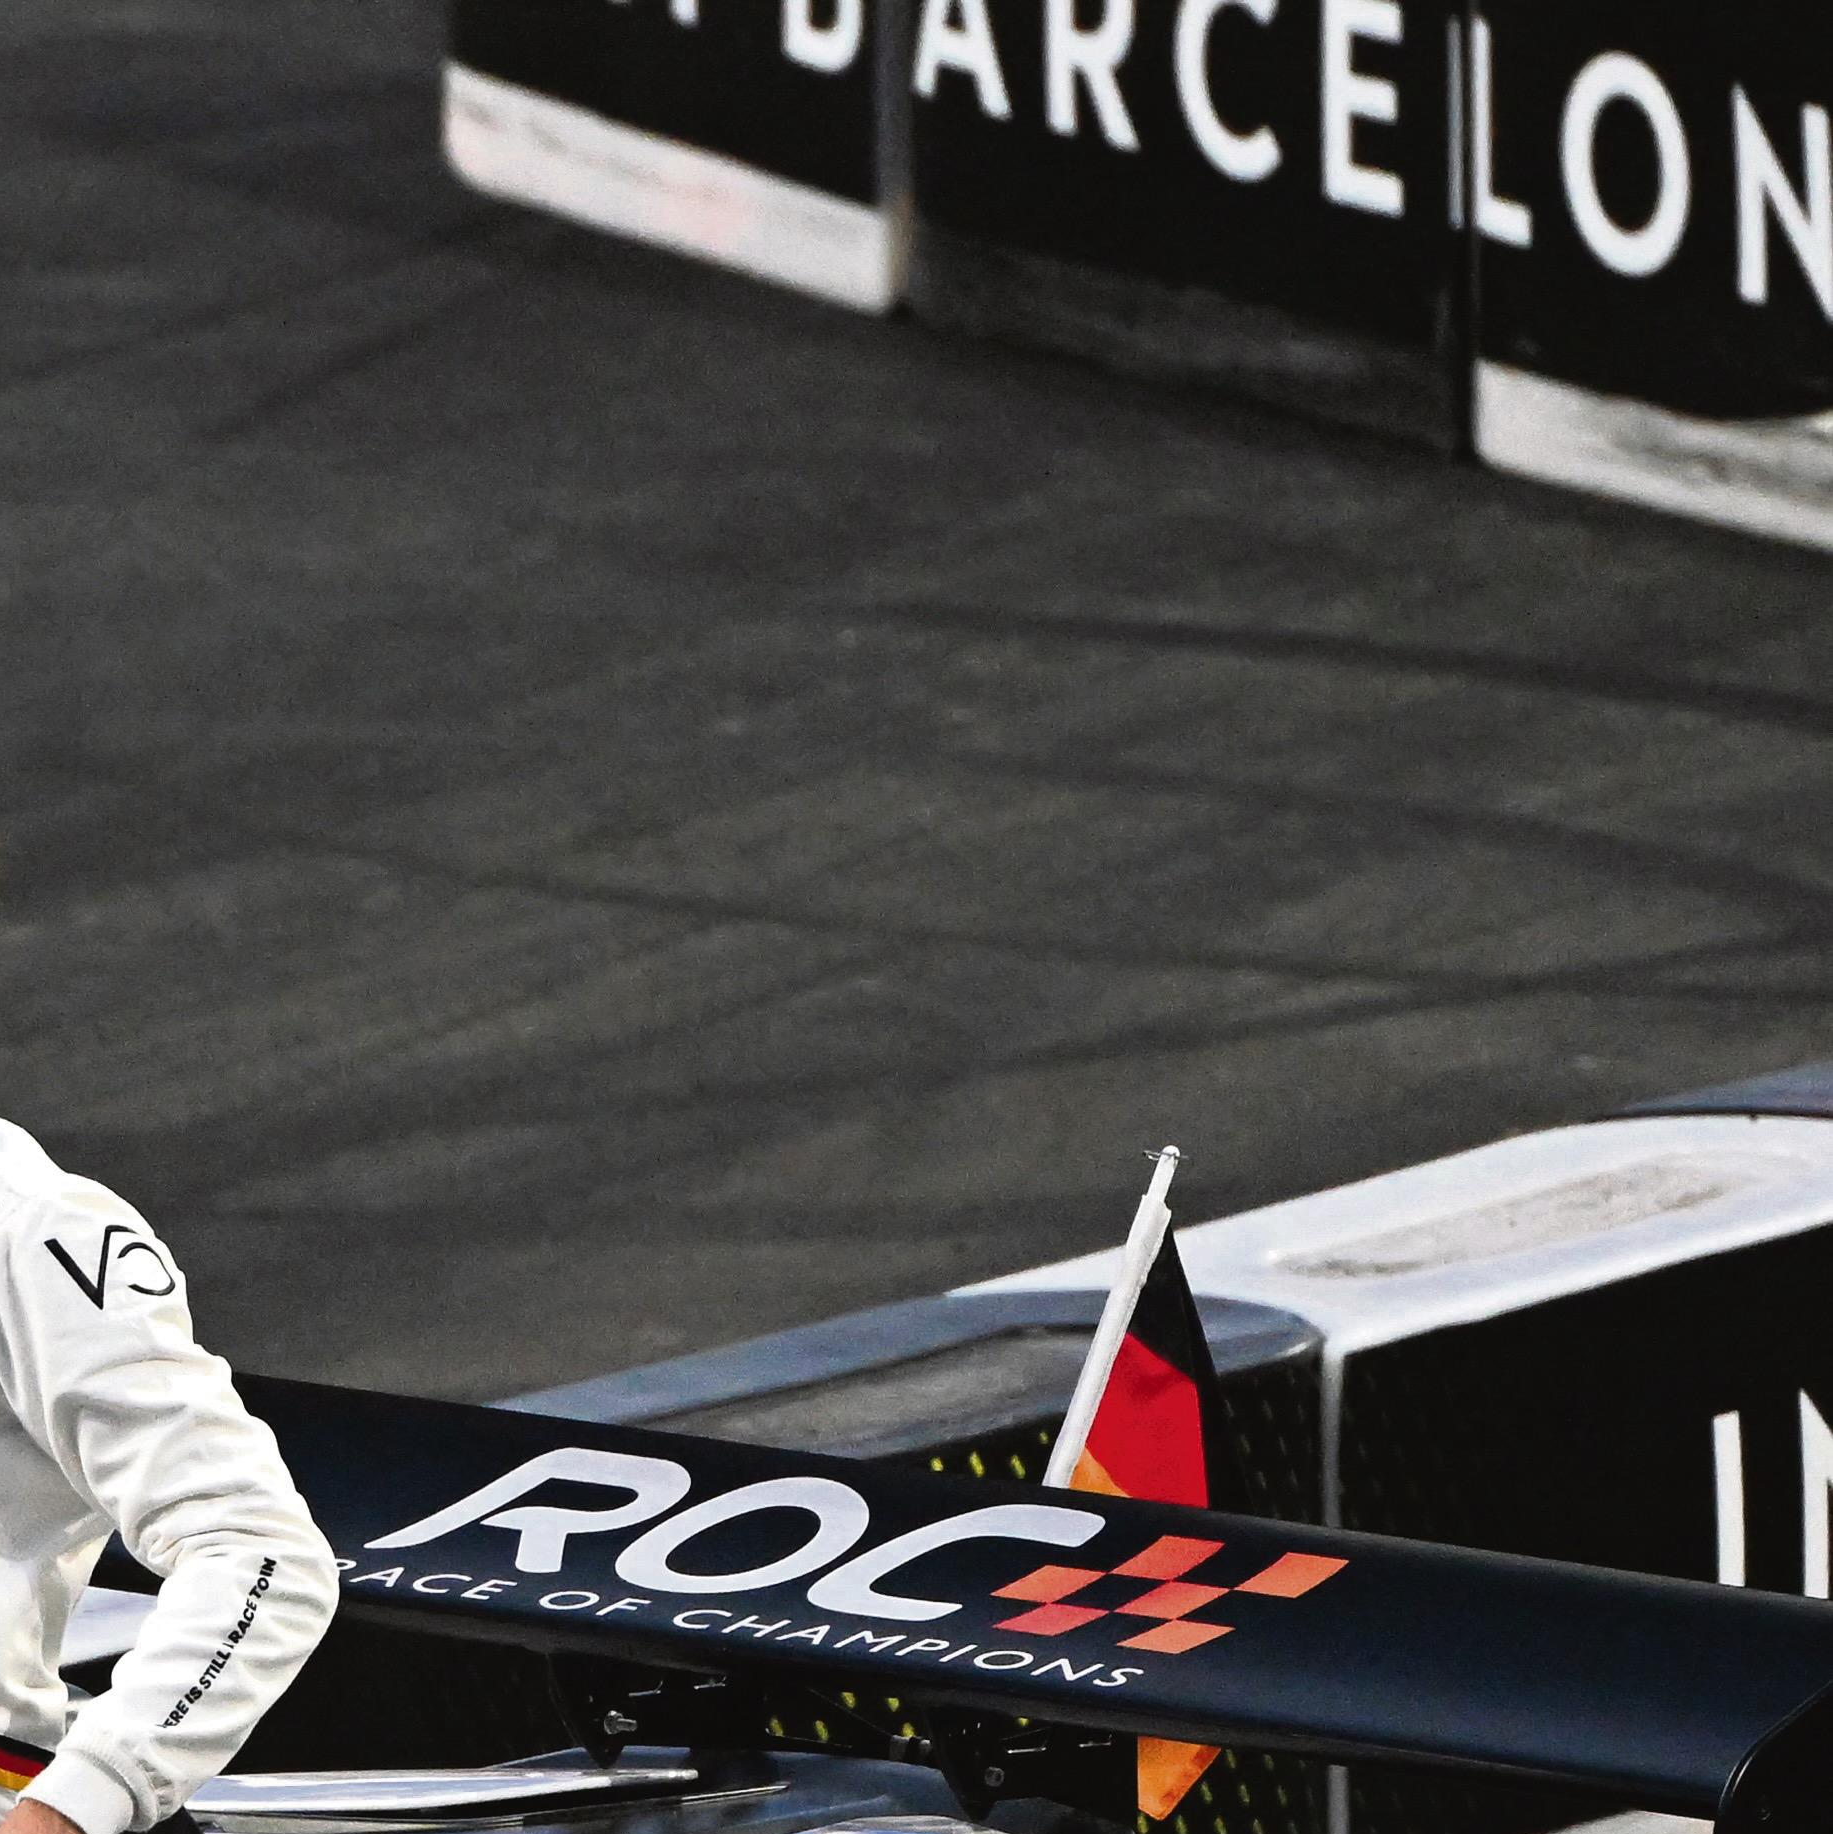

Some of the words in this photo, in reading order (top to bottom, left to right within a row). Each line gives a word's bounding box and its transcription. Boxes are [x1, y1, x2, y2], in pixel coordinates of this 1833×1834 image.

[362, 1447, 1105, 1621] ROC
[199, 1650, 231, 1690] STILL
[228, 1598, 257, 1644] RACE
[538, 1591, 651, 1617] OF
[673, 1608, 1145, 1689] CHAMPIONS
